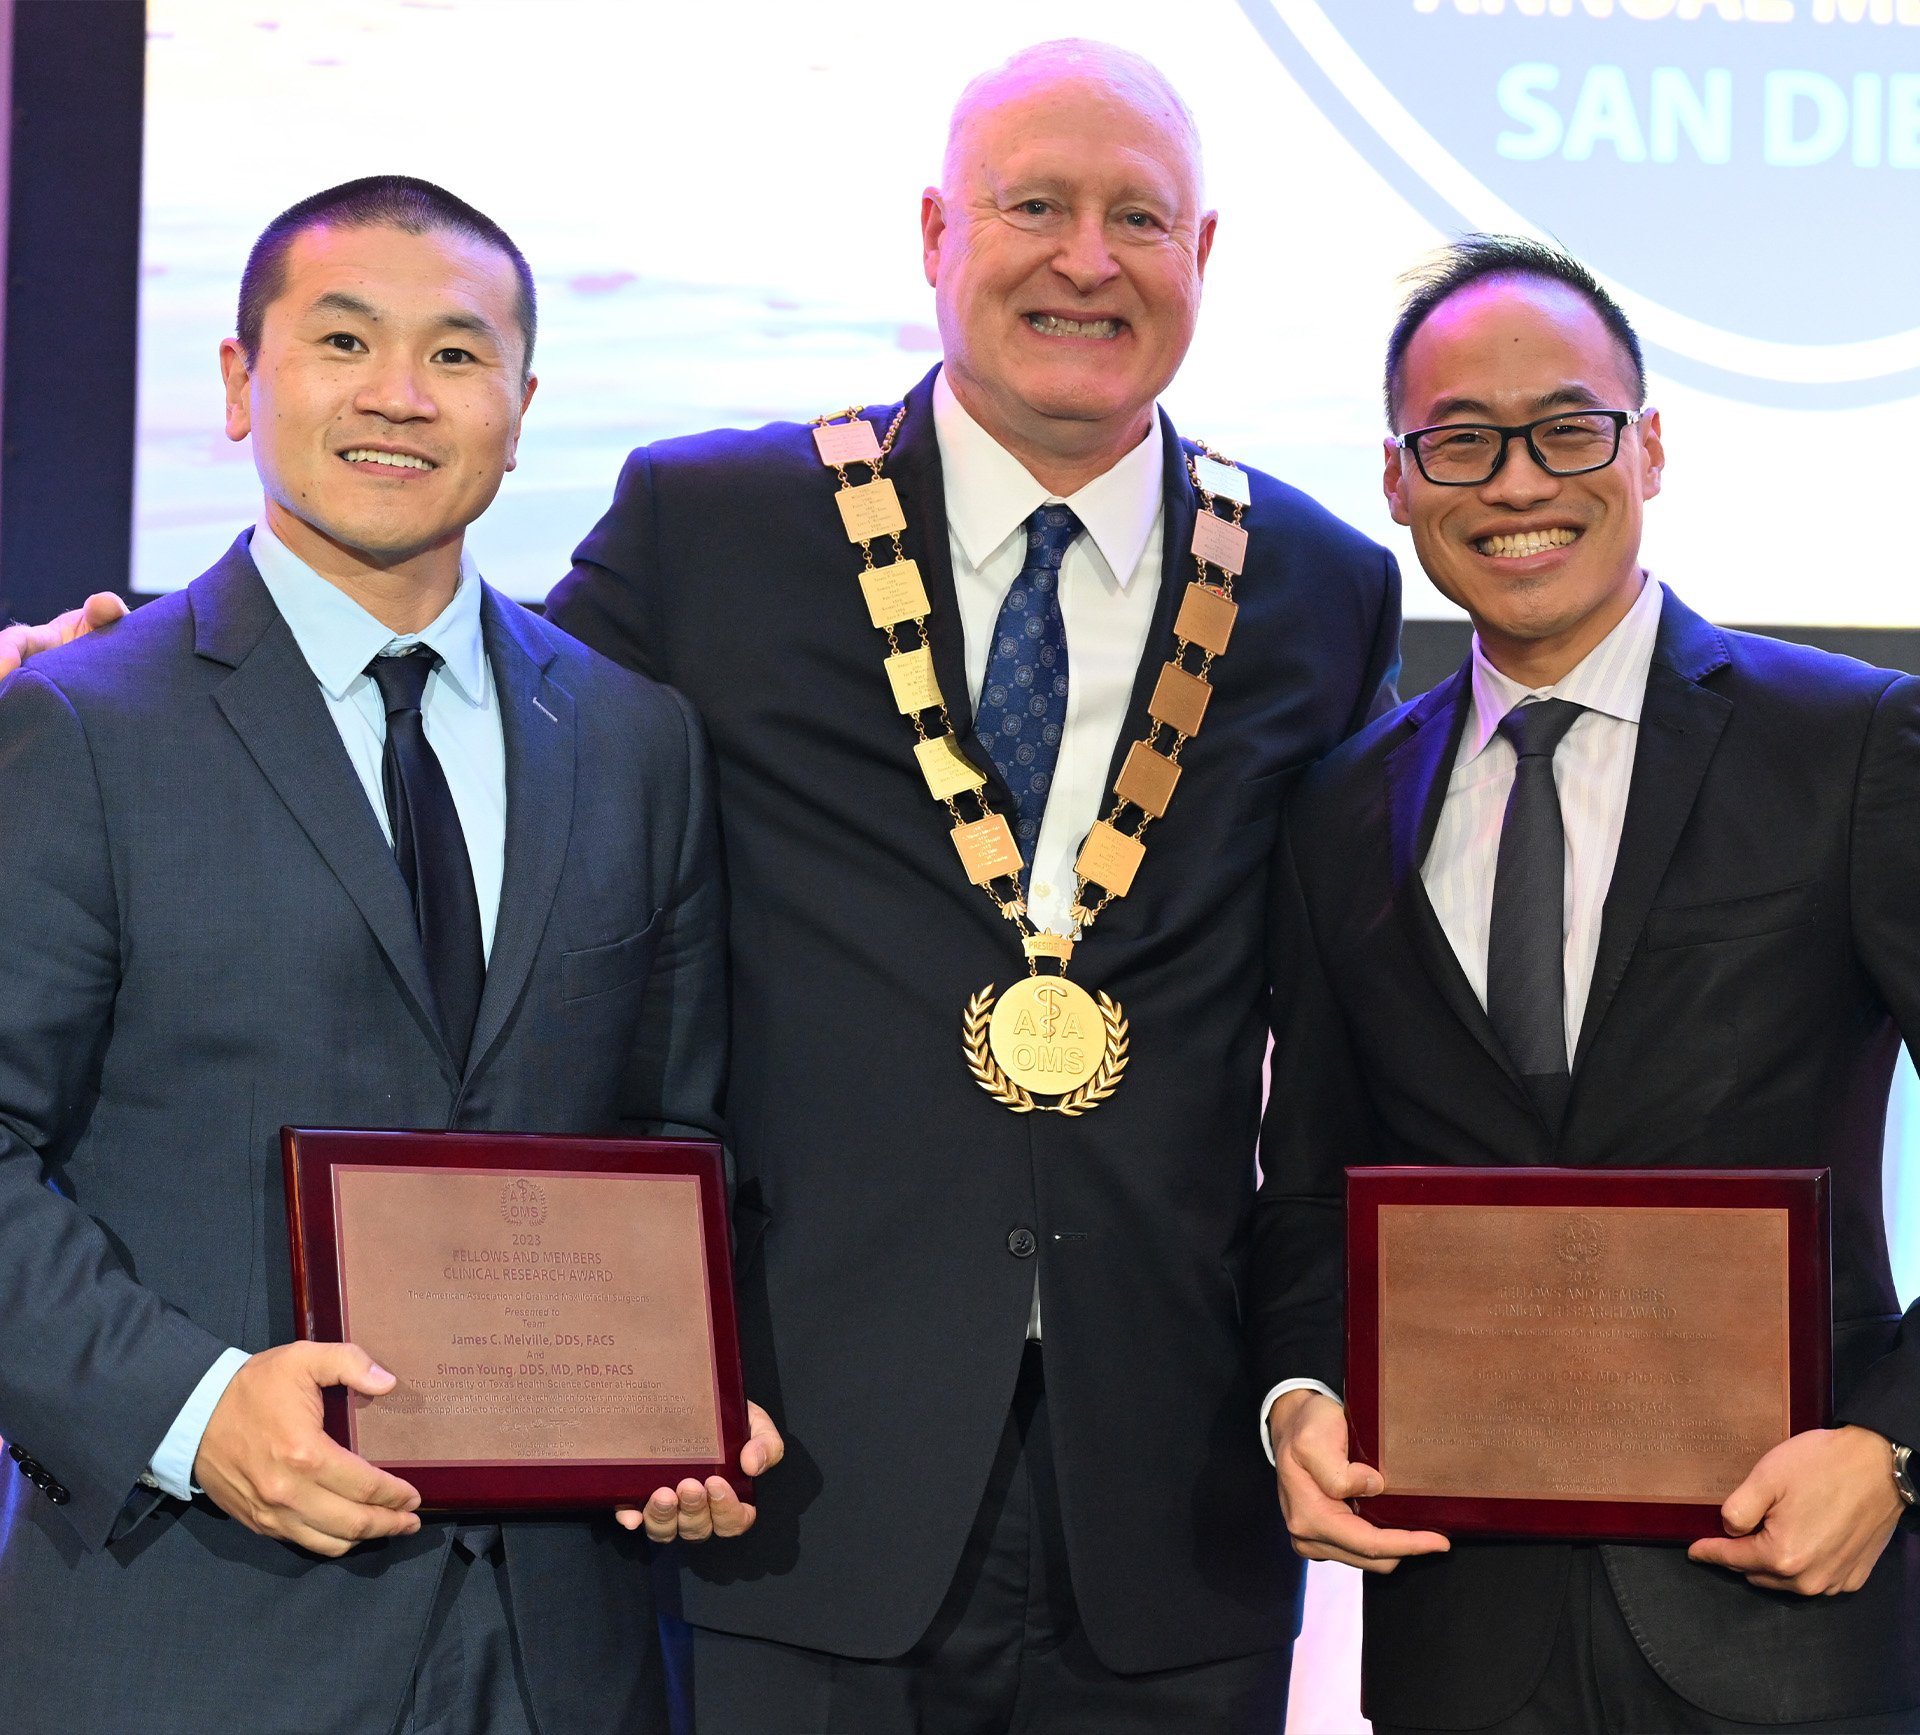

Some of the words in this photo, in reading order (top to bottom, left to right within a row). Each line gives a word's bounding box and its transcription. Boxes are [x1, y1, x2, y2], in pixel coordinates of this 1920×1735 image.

[1496, 62, 1733, 165] SAN
[1012, 1044, 1085, 1075] OMS
[510, 1206, 539, 1218] OMS
[512, 1233, 541, 1246] 2023
[453, 1249, 509, 1262] FELLOWS
[512, 1251, 540, 1264] AND
[543, 1252, 602, 1265] MEMBERS
[443, 1267, 500, 1280] CLINICAL
[503, 1268, 566, 1281] RESEARCH
[569, 1270, 613, 1282] AWARD
[408, 1290, 424, 1299] The
[426, 1290, 464, 1300] American
[467, 1291, 513, 1300] Association
[515, 1291, 523, 1300] of
[613, 1294, 650, 1304] Surgeons
[1568, 1287, 1594, 1300] AND
[1599, 1288, 1665, 1301] MEMBERS
[505, 1307, 548, 1317] Presented
[551, 1308, 560, 1317] to
[1626, 1305, 1677, 1319] AWARD
[523, 1319, 545, 1328] Team
[452, 1334, 487, 1345] James
[490, 1334, 501, 1345] C.
[504, 1334, 552, 1347] Melville,
[555, 1334, 583, 1347] DDS,
[586, 1335, 615, 1346] FACS
[527, 1350, 545, 1359] And
[437, 1363, 474, 1375] Simon
[476, 1363, 516, 1378] Young,
[519, 1364, 548, 1376] DDS,
[551, 1364, 574, 1377] MD,
[576, 1364, 602, 1377] PhD,
[605, 1364, 634, 1376] FACS
[410, 1379, 427, 1388] The
[429, 1379, 474, 1391] University
[478, 1379, 487, 1388] of
[489, 1380, 514, 1389] Texas
[517, 1380, 545, 1389] Health
[547, 1380, 581, 1389] Science
[584, 1380, 613, 1389] Center
[615, 1381, 623, 1389] at
[626, 1380, 662, 1389] Houston
[479, 1405, 487, 1413] to
[535, 1404, 567, 1415] practice
[569, 1404, 577, 1413] of
